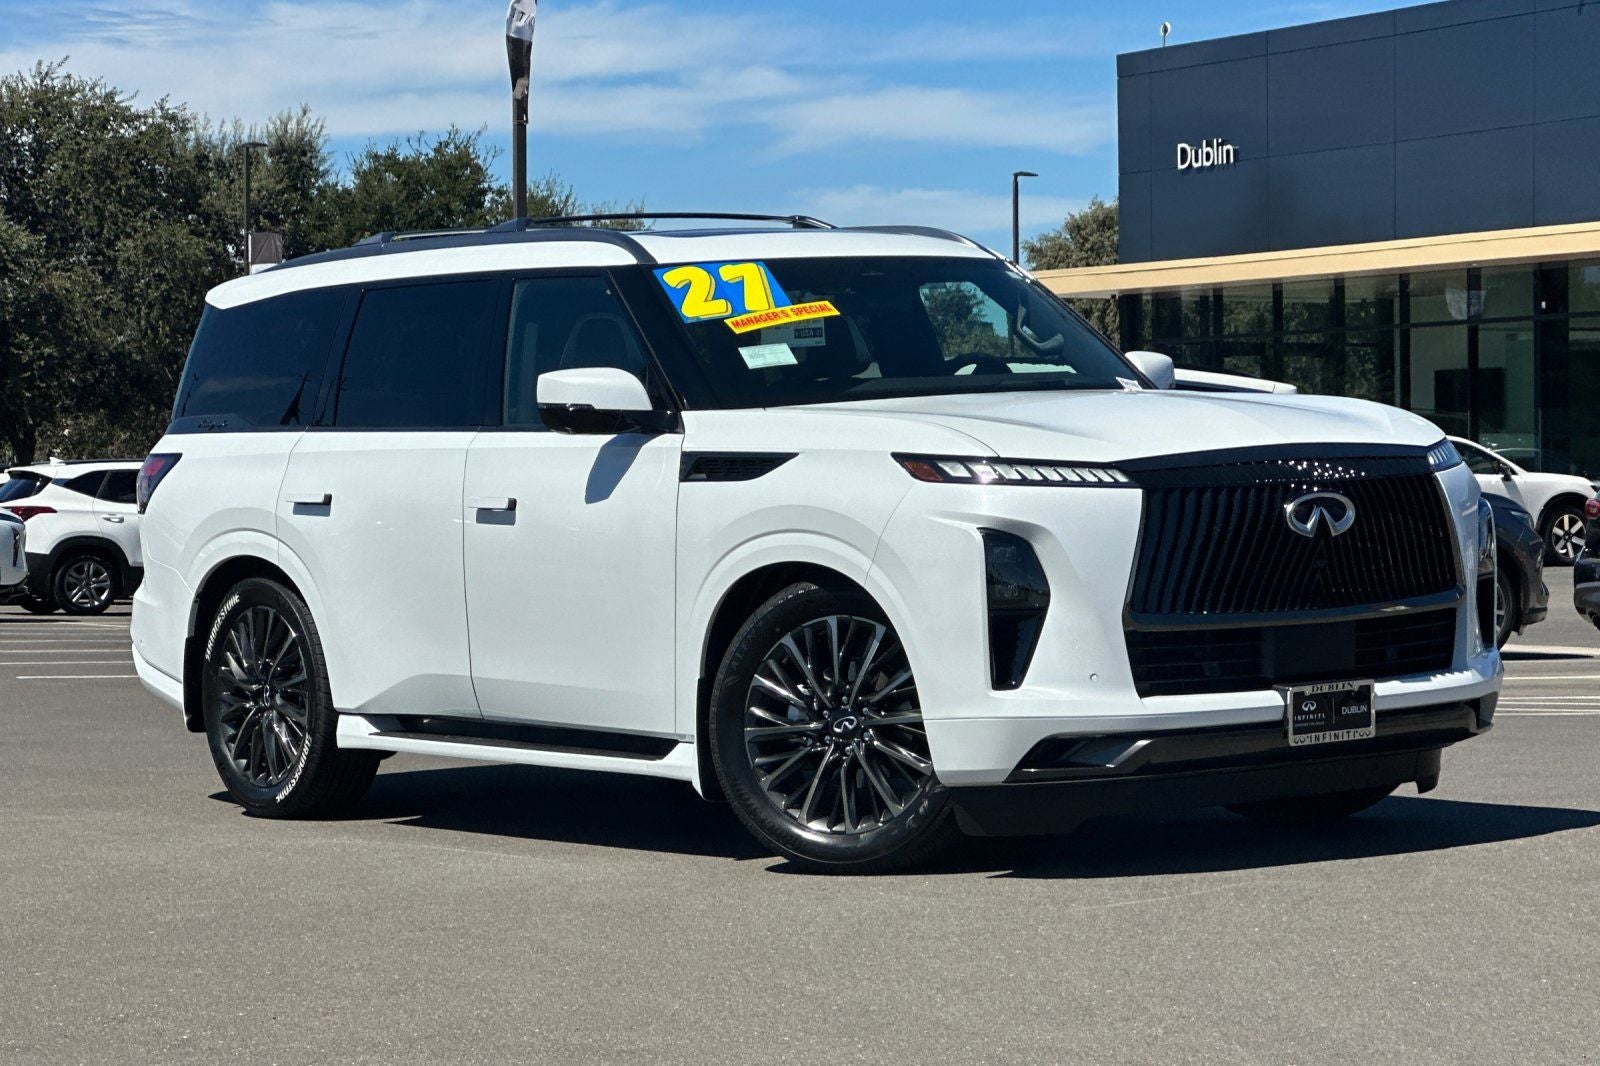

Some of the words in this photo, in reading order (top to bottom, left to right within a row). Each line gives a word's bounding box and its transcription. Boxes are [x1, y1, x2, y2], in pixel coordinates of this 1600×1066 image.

[1177, 138, 1234, 170] Dublin
[662, 262, 776, 318] 27
[730, 310, 789, 329] MANAGER'S
[792, 302, 833, 317] SPECIAL
[1311, 682, 1355, 693] DUBLIN
[1294, 713, 1326, 721] INFINITI
[1341, 705, 1368, 715] DUBLIN
